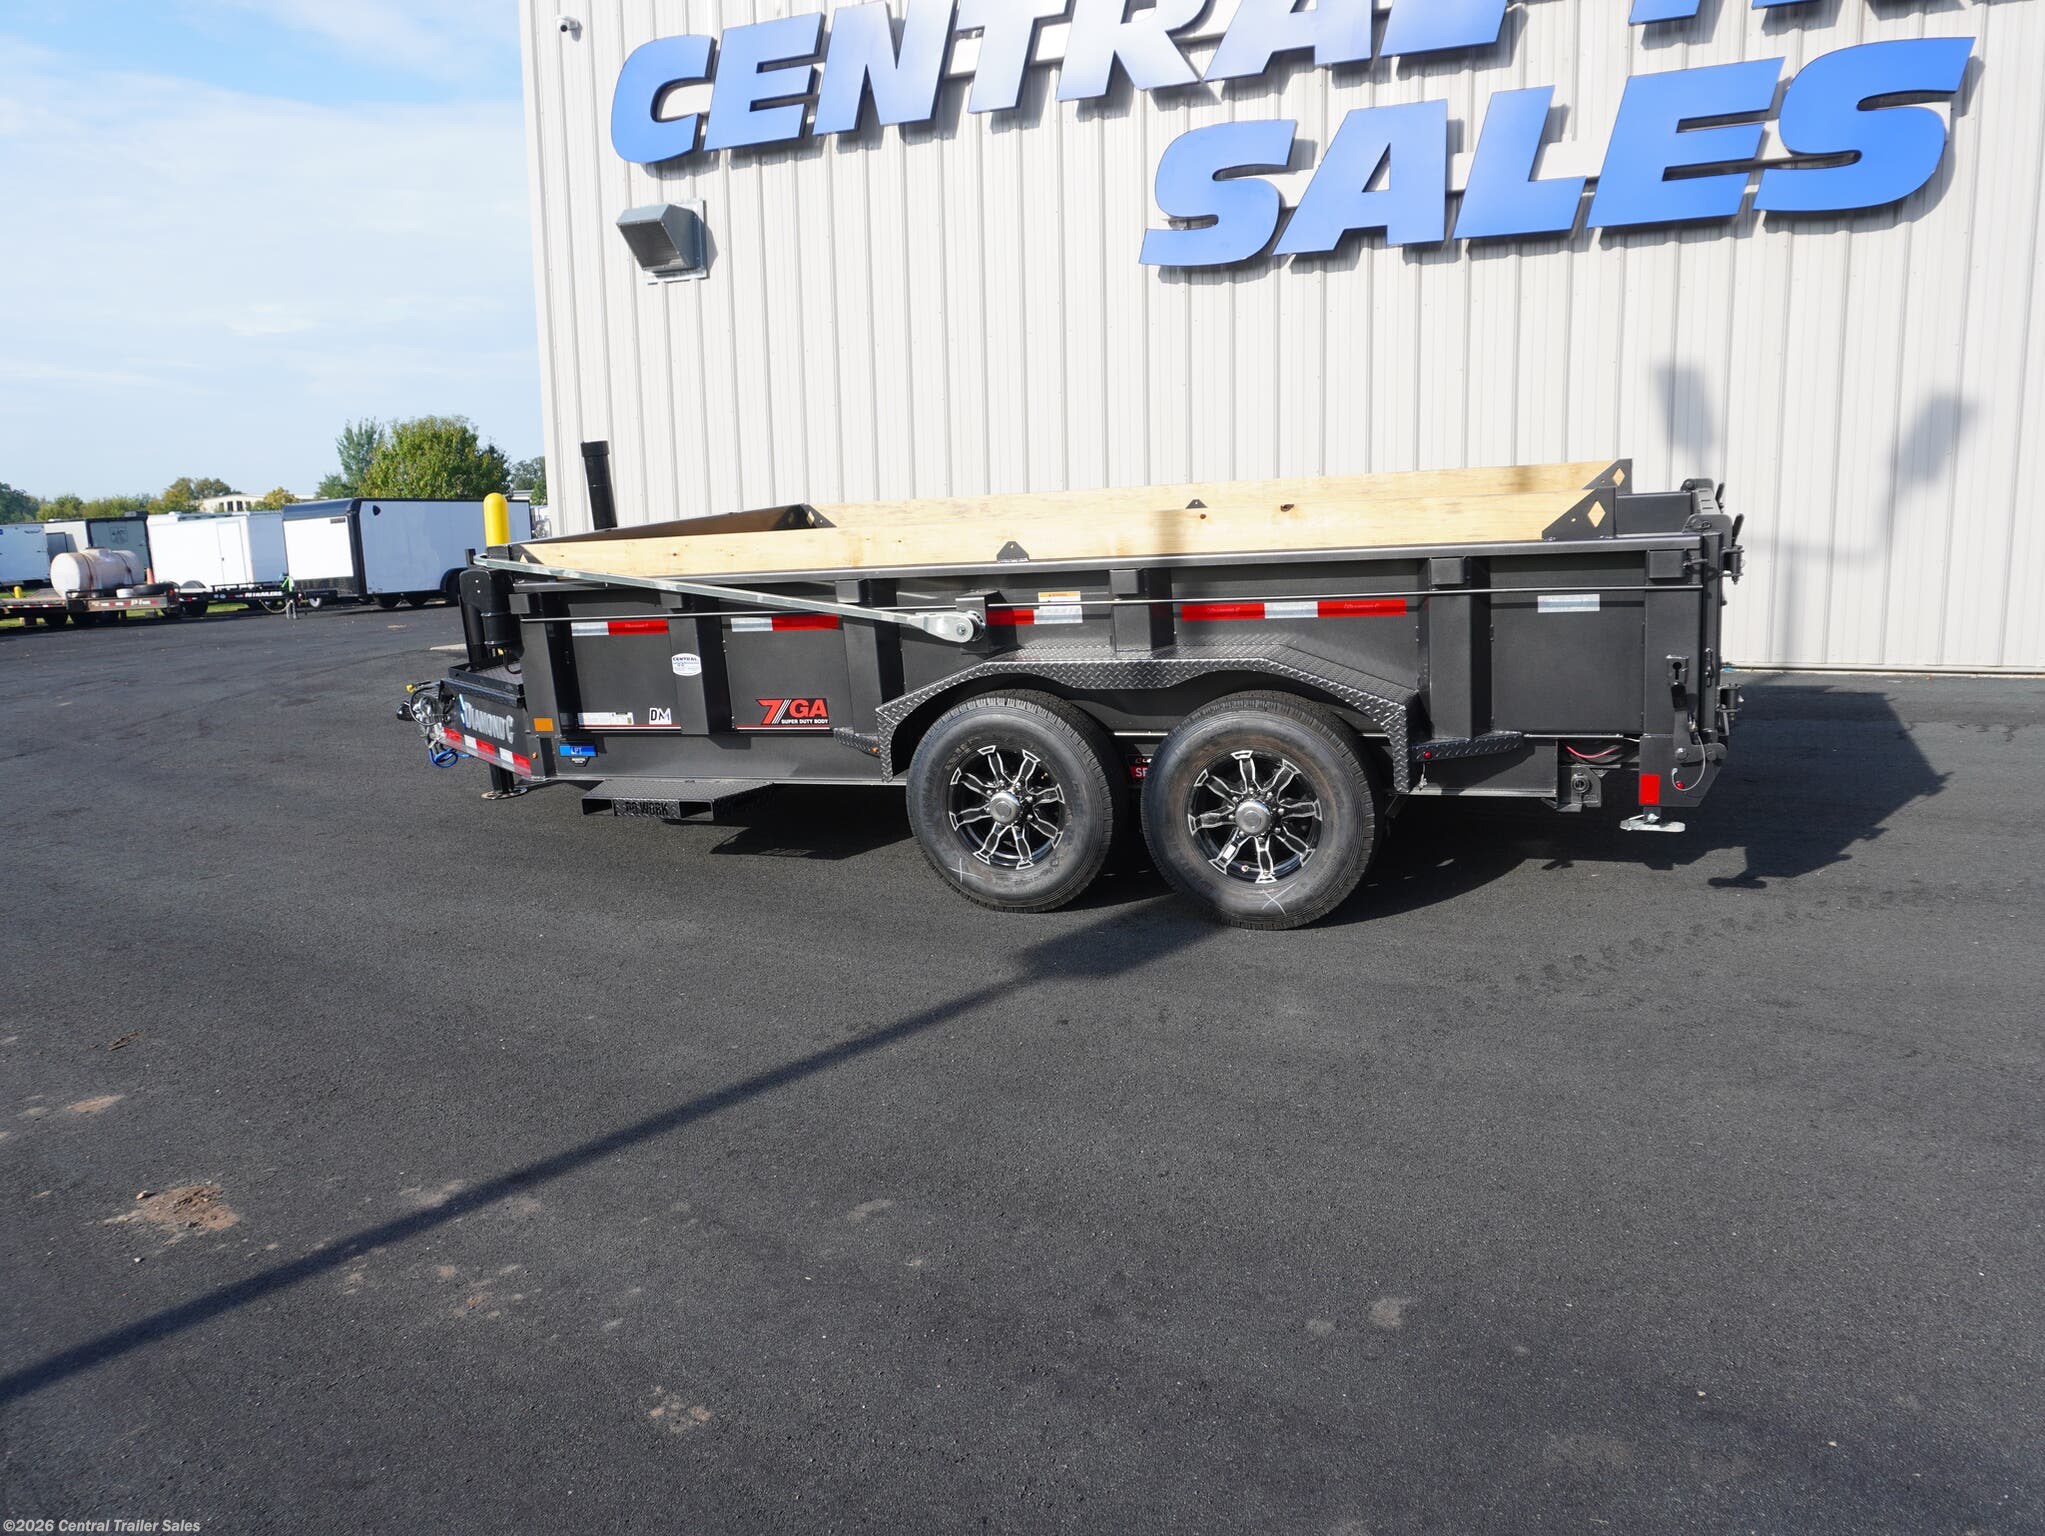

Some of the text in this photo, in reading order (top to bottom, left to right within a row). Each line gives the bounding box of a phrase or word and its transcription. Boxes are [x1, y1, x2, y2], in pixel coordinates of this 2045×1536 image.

[1139, 37, 1976, 267] SALES
[650, 709, 671, 721] DM
[639, 801, 669, 816] WORK
